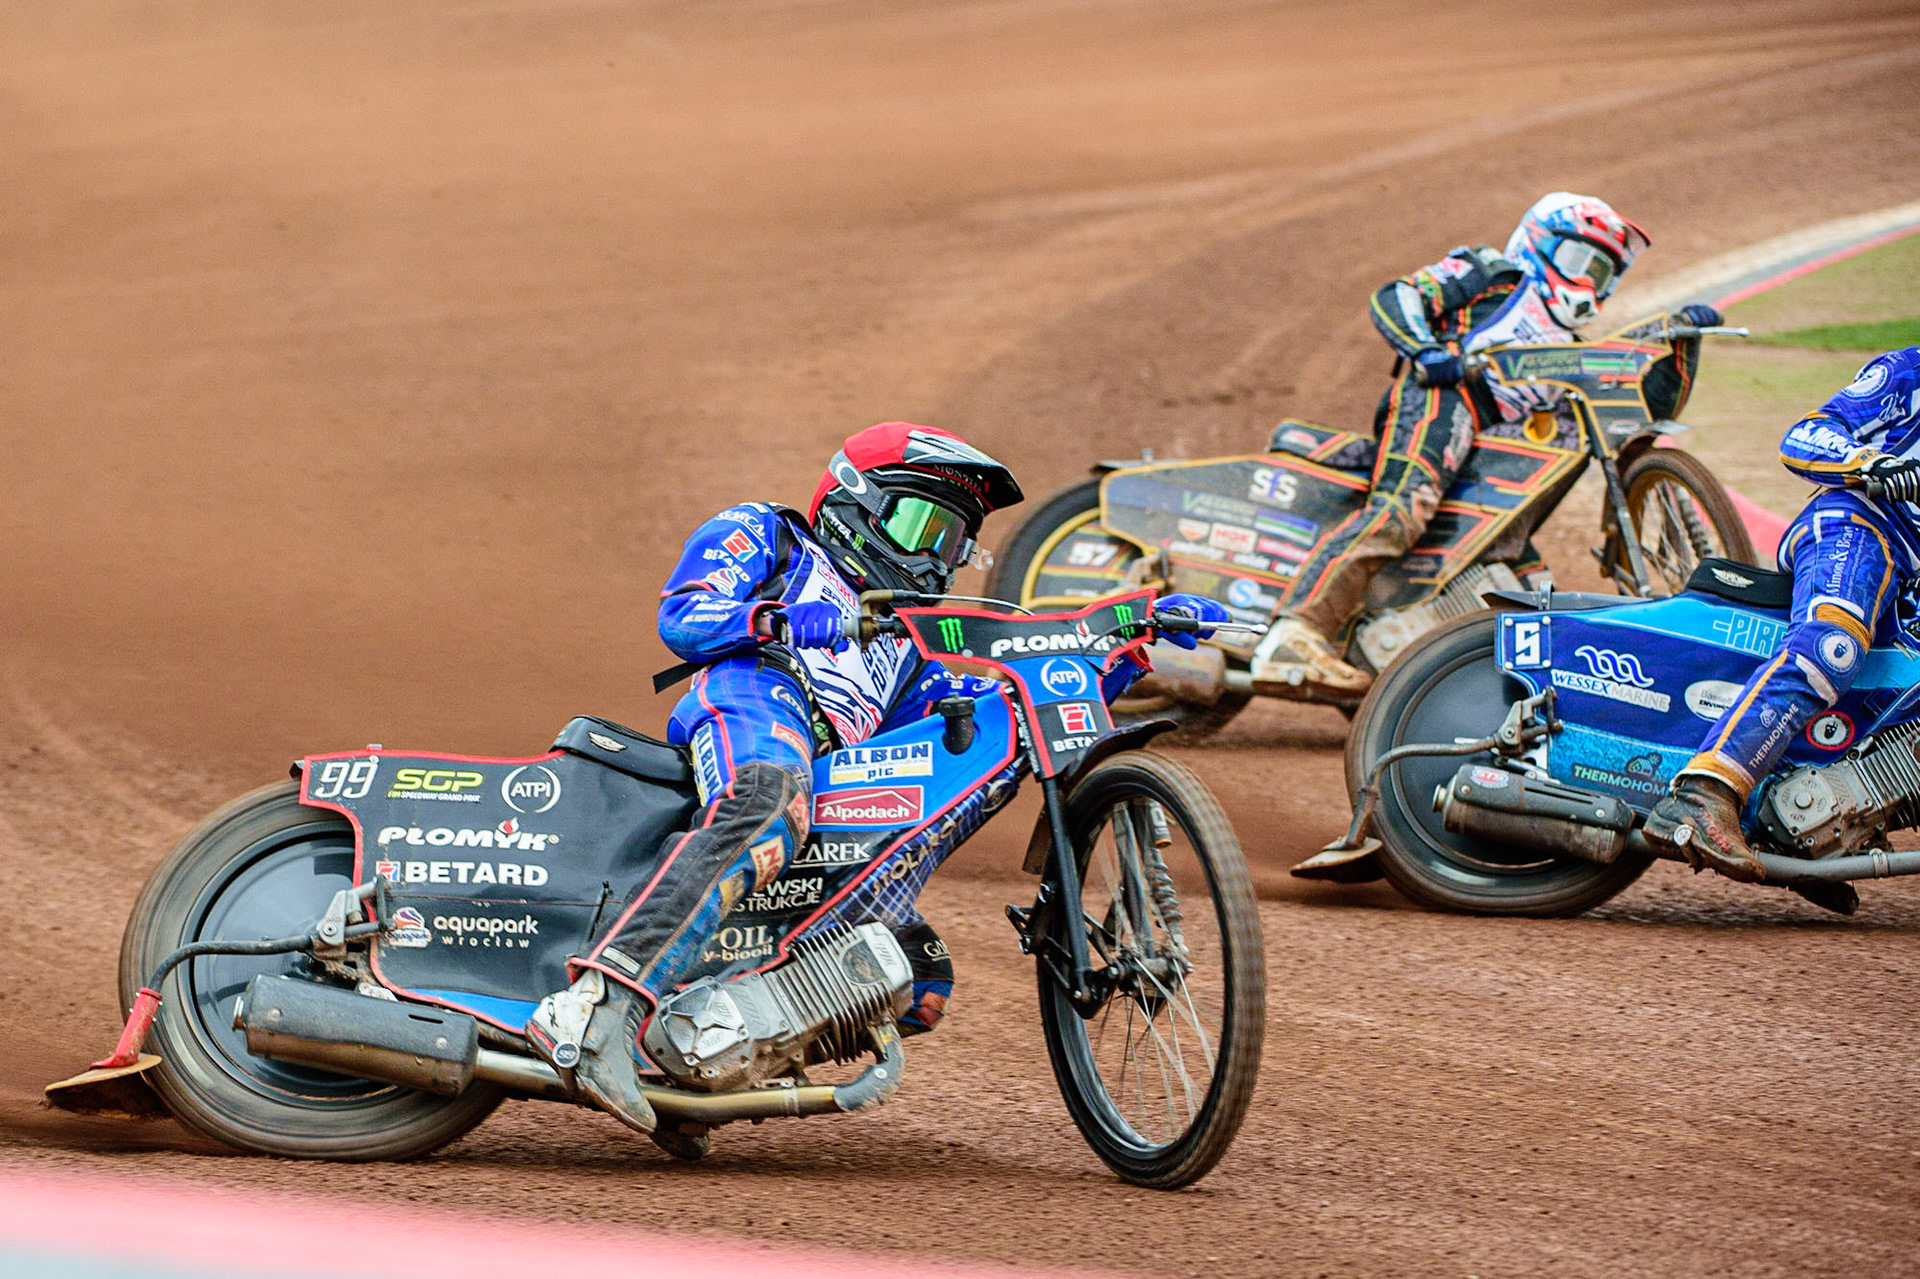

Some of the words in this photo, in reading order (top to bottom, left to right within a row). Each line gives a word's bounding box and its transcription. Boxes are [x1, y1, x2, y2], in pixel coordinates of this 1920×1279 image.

[703, 548, 751, 583] BETARD
[1066, 541, 1119, 566] 57
[1049, 670, 1080, 685] ATPI
[1748, 703, 1799, 769] THERMOHOME
[696, 725, 721, 799] ALBON
[834, 743, 929, 767] ALBON
[314, 761, 379, 799] 99
[393, 768, 484, 792] SGP
[510, 780, 551, 798] ATPI
[1573, 765, 1669, 796] THERMOHOM
[821, 804, 910, 822] Alpodach
[405, 862, 549, 887] BETARD
[753, 877, 824, 898] WSKI
[432, 914, 539, 938] aquapark
